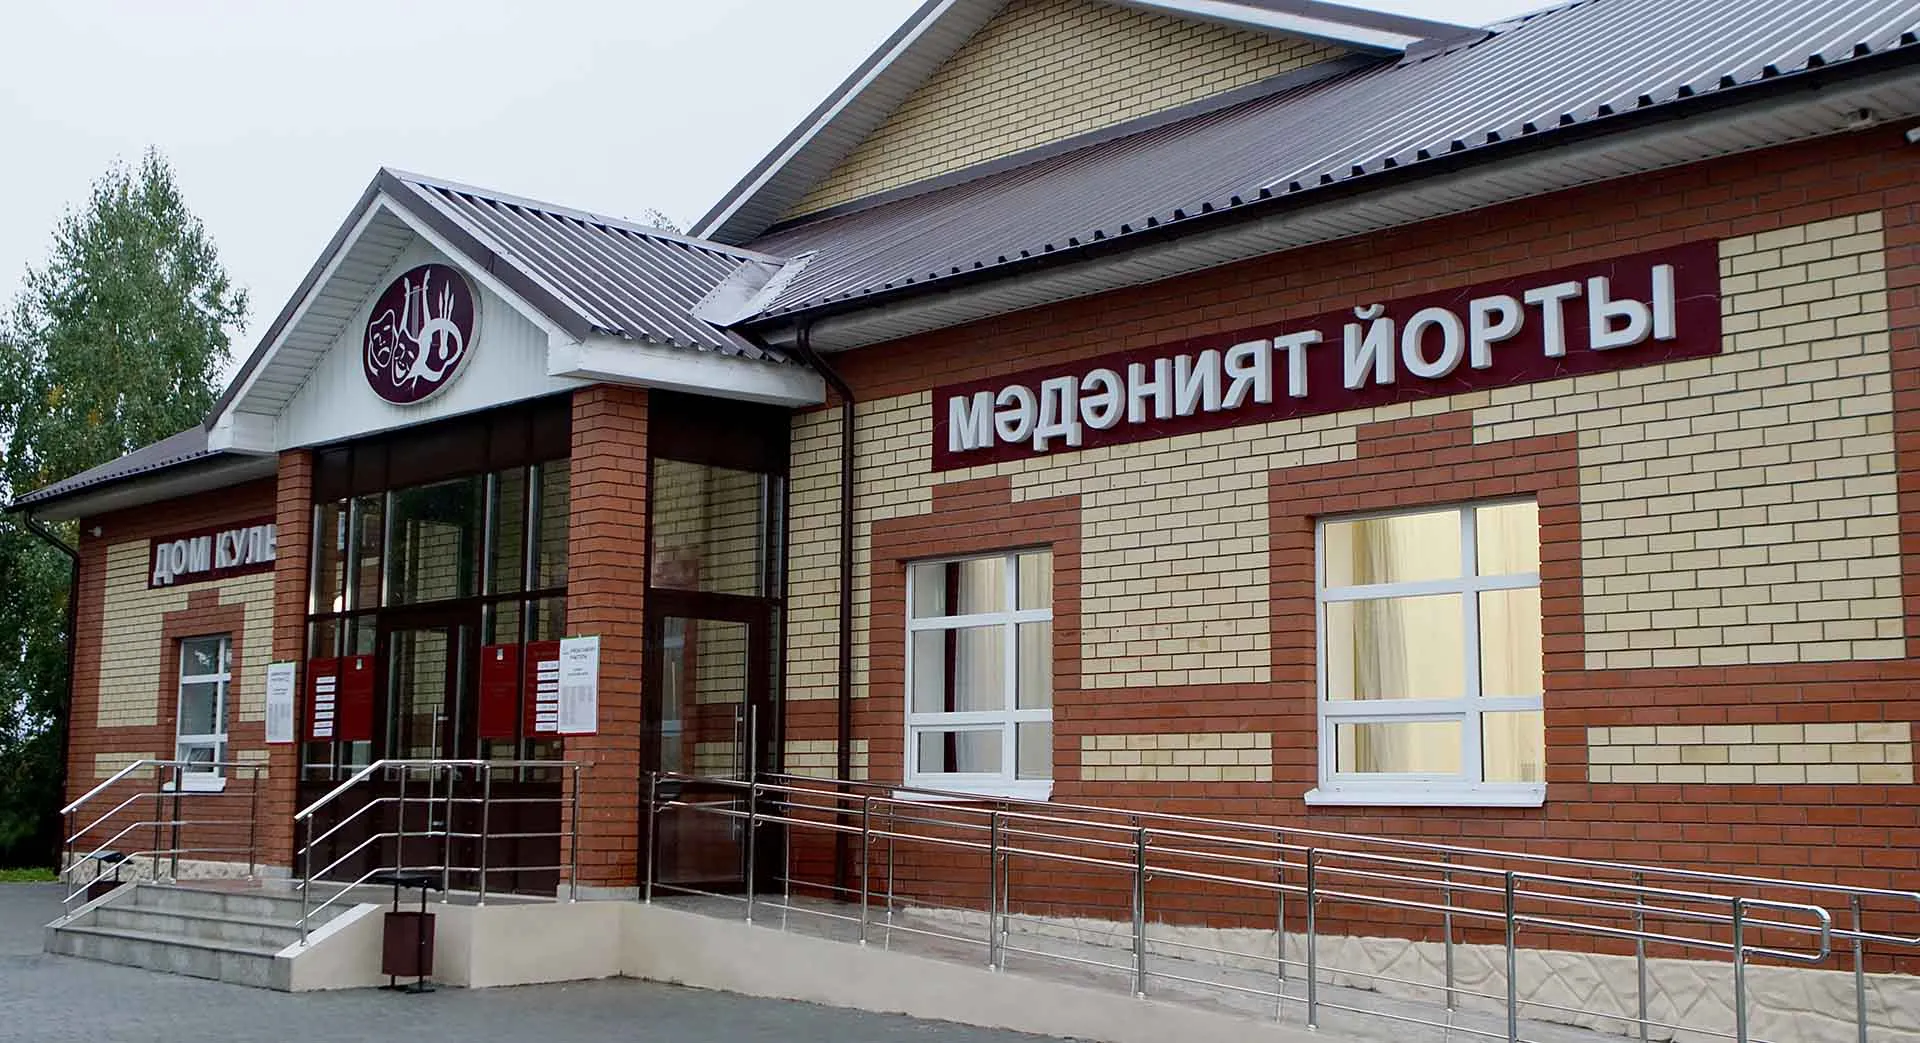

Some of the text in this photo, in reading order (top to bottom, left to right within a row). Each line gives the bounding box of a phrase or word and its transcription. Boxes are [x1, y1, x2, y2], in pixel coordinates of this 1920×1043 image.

[948, 263, 1676, 453] МӘДӘНИЯТ ЙОРТЫ
[153, 535, 212, 586] ДОМ
